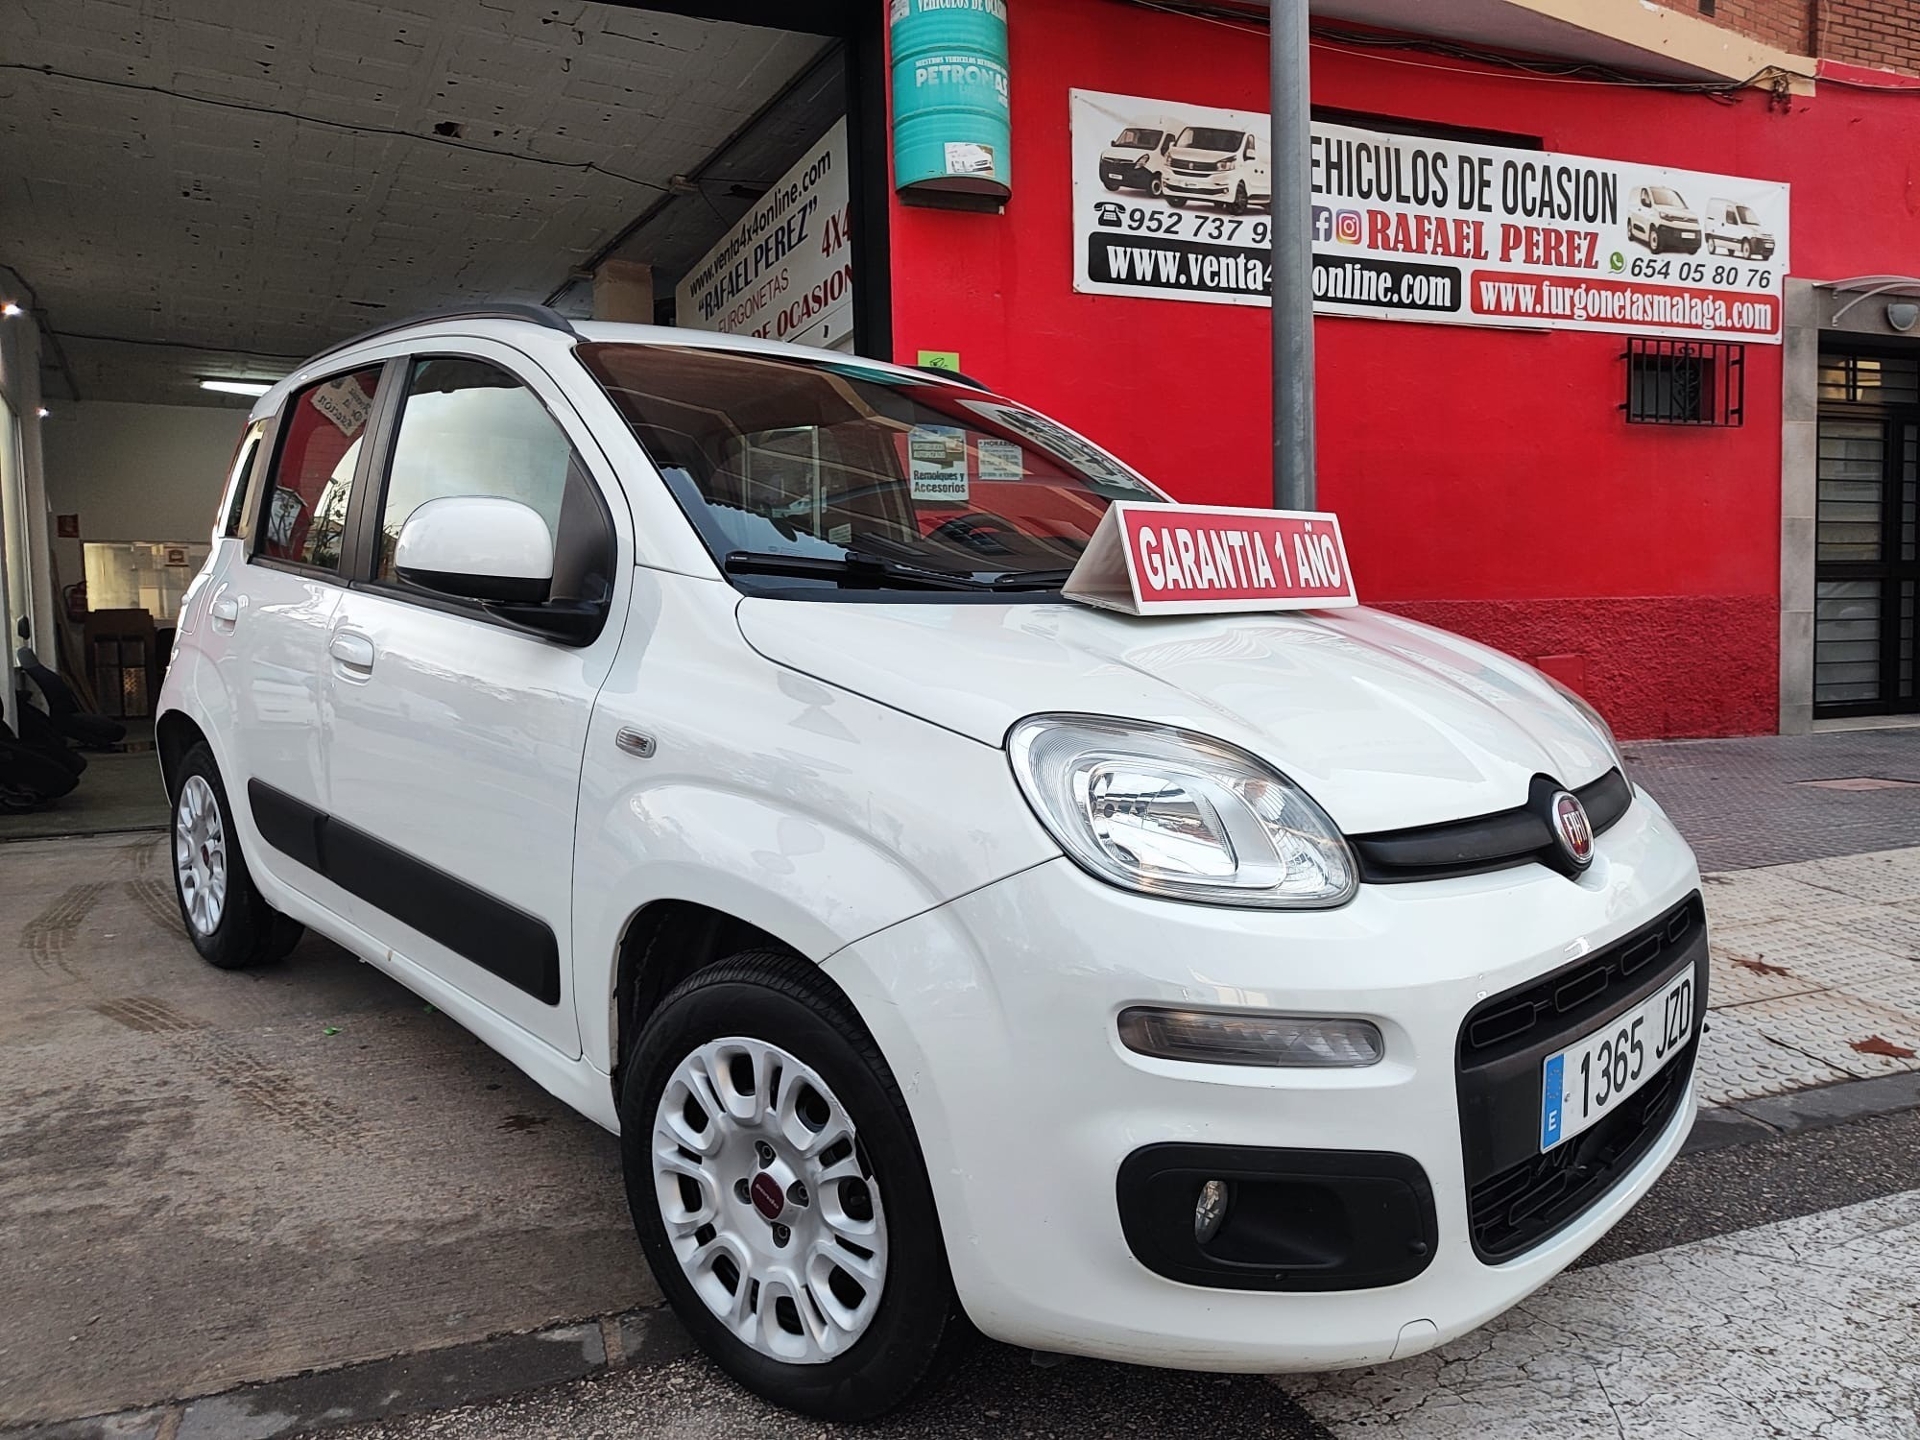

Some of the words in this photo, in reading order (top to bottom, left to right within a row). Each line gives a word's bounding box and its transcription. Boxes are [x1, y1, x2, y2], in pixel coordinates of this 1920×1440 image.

[916, 65, 1009, 97] PETRONAS
[1311, 135, 1448, 208] EHICULOS
[1458, 154, 1493, 212] DE
[1502, 159, 1618, 225] OCASION
[689, 151, 831, 298] www.venta4x4online.com
[1127, 207, 1183, 235] 952
[1192, 213, 1243, 242] 737
[1367, 209, 1489, 260] RAFAEL
[1499, 222, 1600, 270] PEREZ
[718, 267, 789, 334] FURGONETAS
[776, 263, 853, 338] OCASION
[1107, 245, 1452, 308] www.ventaonline.com
[1631, 257, 1670, 280] 654
[1678, 261, 1705, 283] 05
[1712, 265, 1738, 287] 80
[1747, 268, 1772, 289] 76
[1479, 279, 1772, 331] www.furgonetasmalaga.com
[913, 470, 957, 482] Remolques
[959, 474, 965, 483] y
[914, 482, 966, 494] Accesorios
[1139, 526, 1277, 591] GARANTIA
[1275, 531, 1292, 588] 1
[1293, 521, 1342, 589] AÑO
[1581, 1015, 1645, 1118] 1365
[1656, 978, 1691, 1060] JZD
[1548, 1110, 1558, 1131] E
